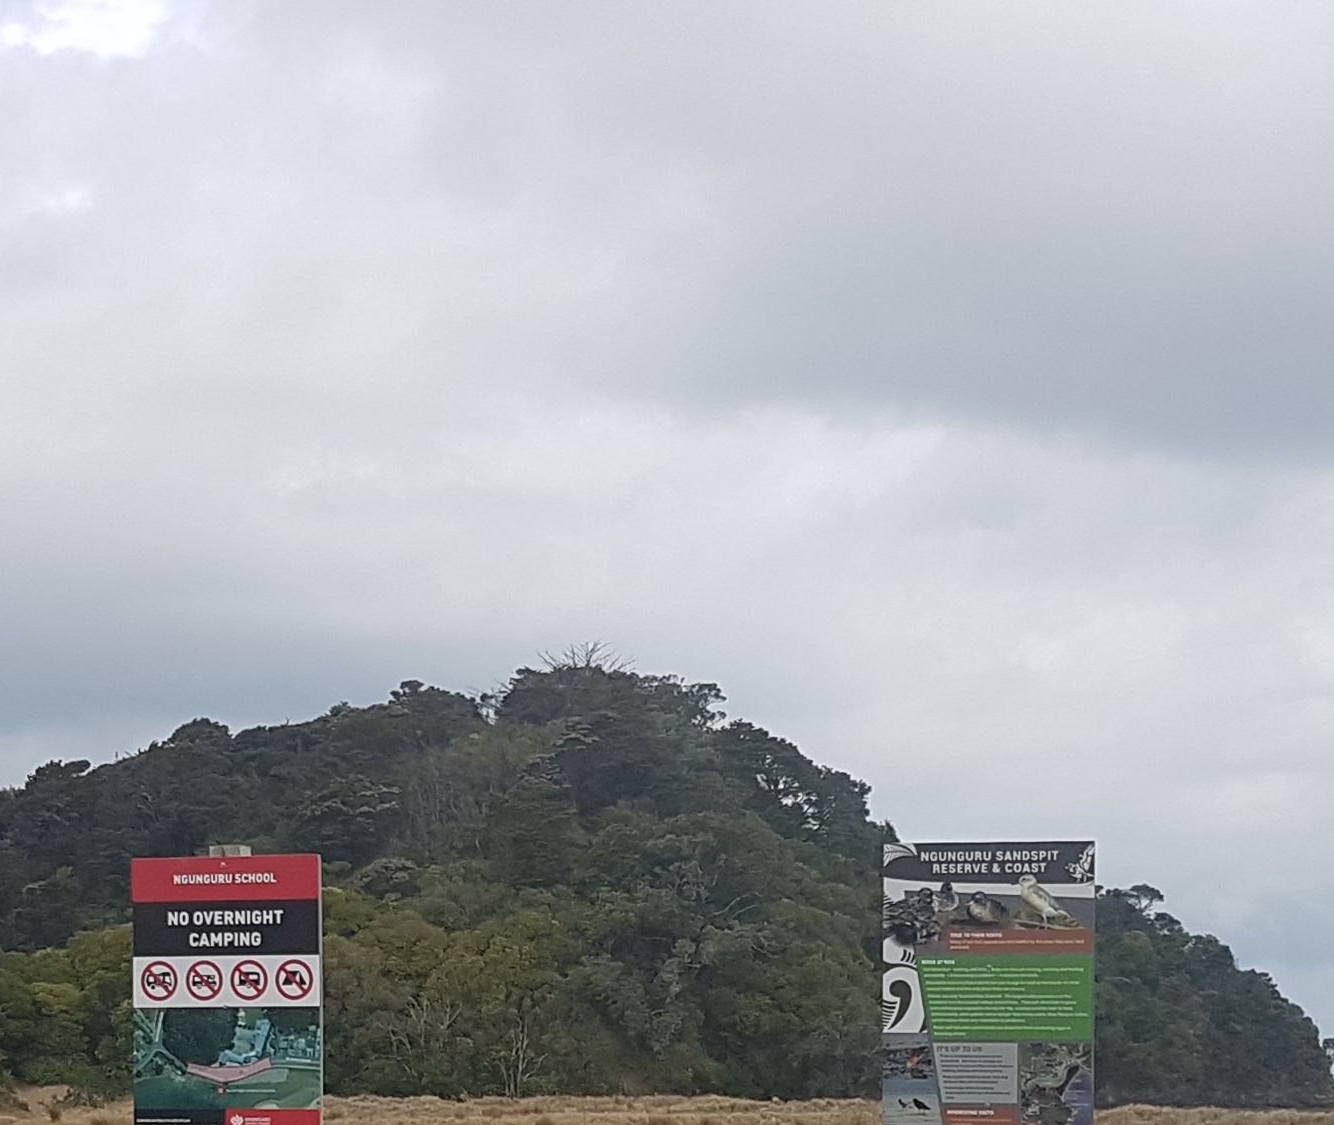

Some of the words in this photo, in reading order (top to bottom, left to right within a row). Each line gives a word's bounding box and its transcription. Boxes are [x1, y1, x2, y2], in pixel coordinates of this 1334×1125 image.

[920, 851, 991, 862] NGUNGURU
[995, 850, 1058, 861] SANDSPIT
[932, 863, 988, 874] RESERVE
[992, 863, 1001, 873] &
[1005, 862, 1047, 873] COAST
[173, 873, 233, 885] NGUNGURU
[234, 872, 277, 884] SCHOOL
[167, 911, 190, 926] NO
[193, 909, 284, 926] OVERNIGHT
[189, 932, 262, 947] CAMPING
